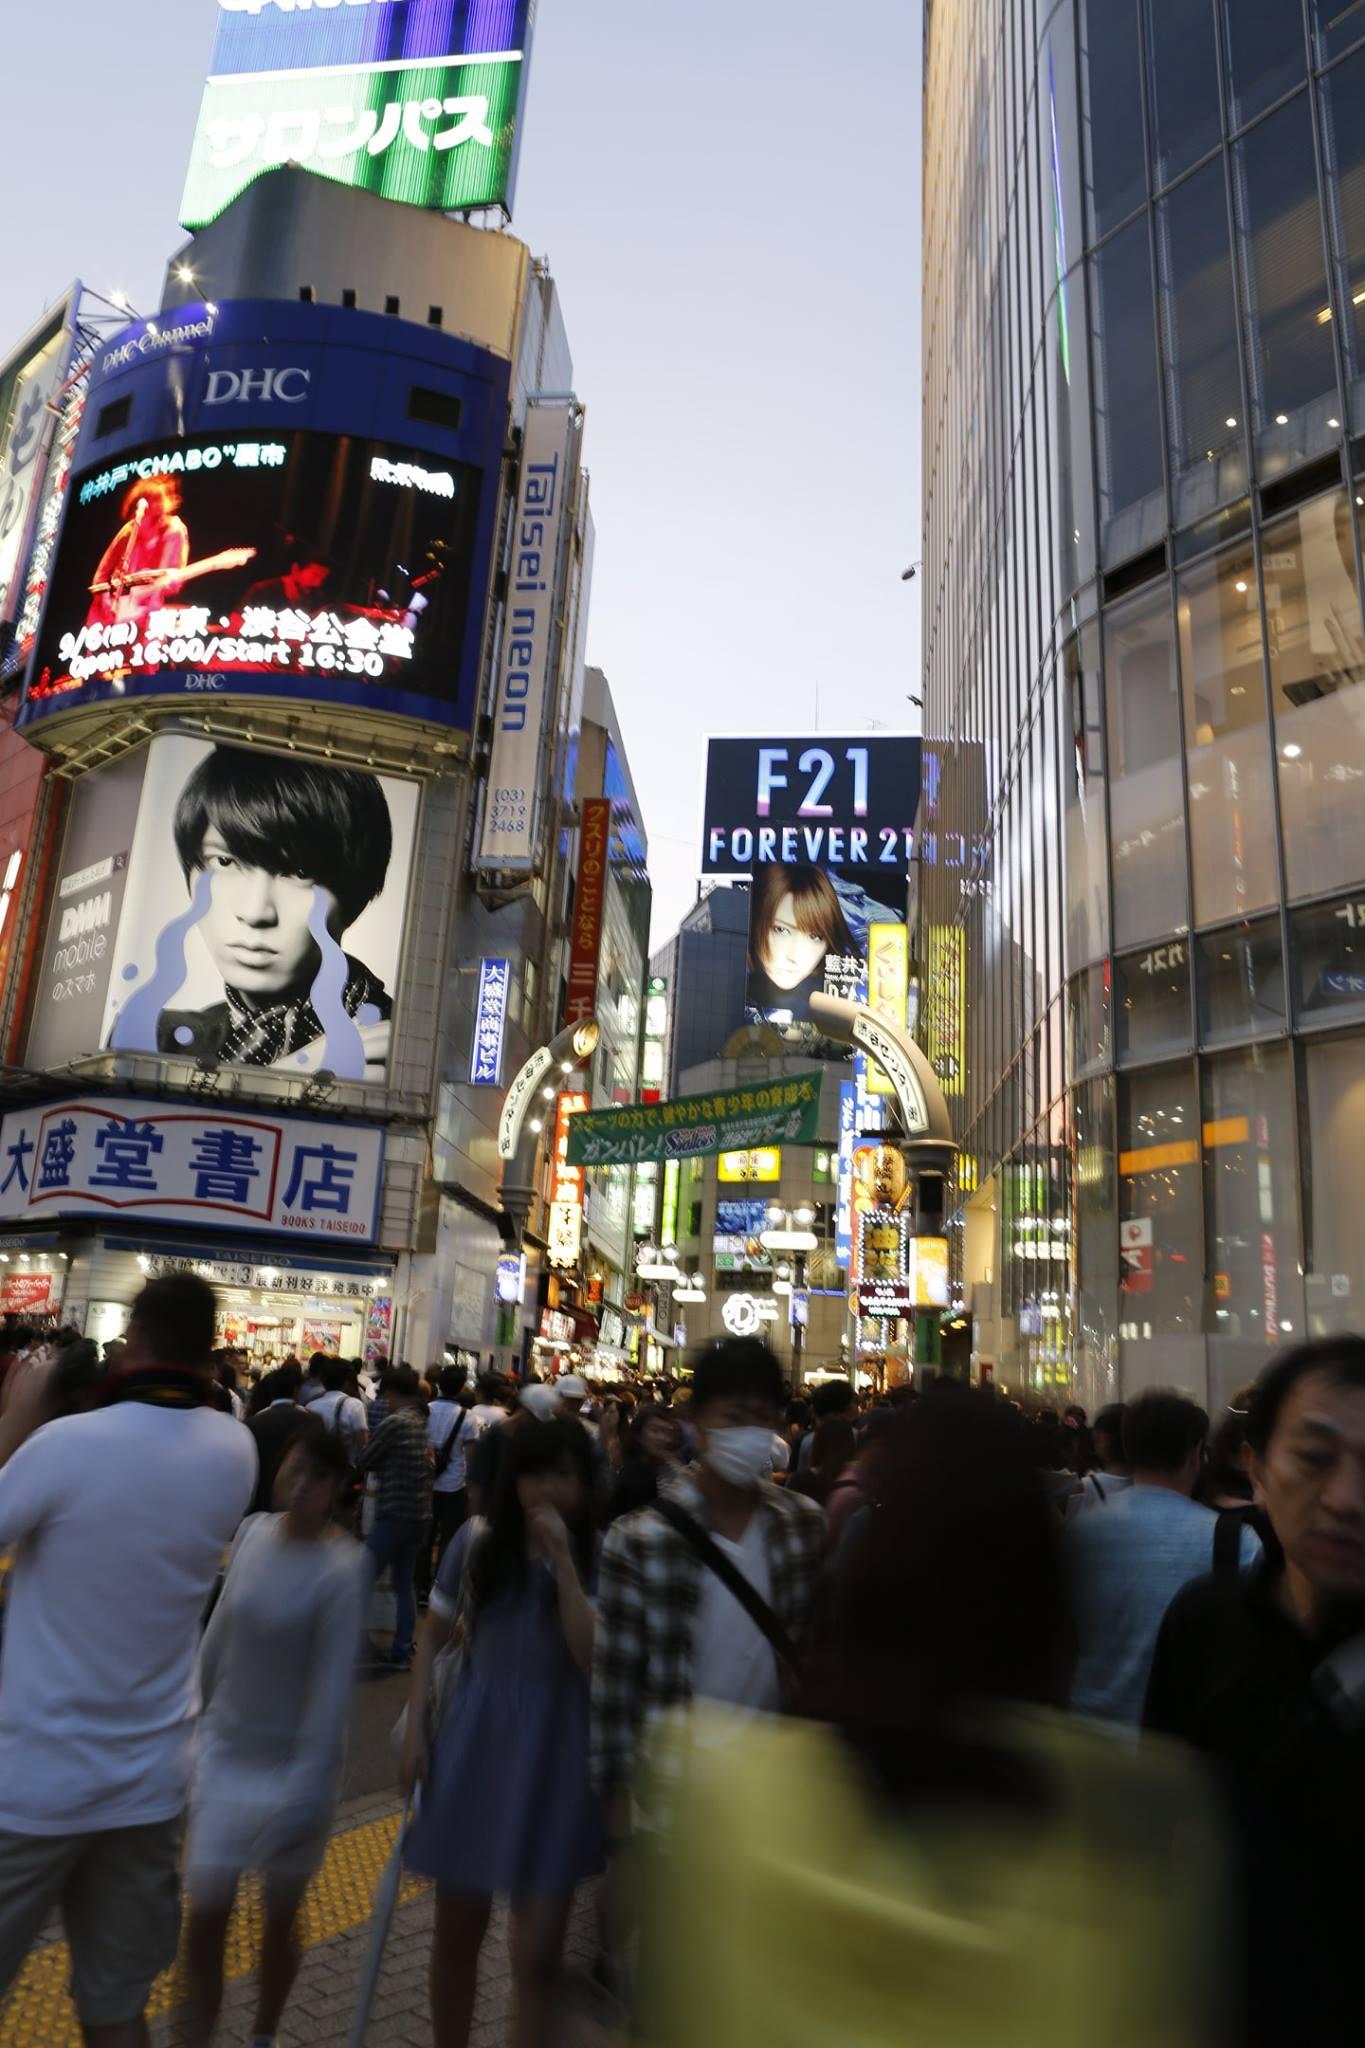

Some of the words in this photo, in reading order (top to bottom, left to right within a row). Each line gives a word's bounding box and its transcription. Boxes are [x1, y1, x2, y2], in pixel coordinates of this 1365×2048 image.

[207, 95, 493, 168] サロンパス
[102, 341, 137, 373] DHC
[138, 316, 214, 353] Channel
[202, 366, 311, 405] DHC
[515, 451, 559, 591] Taisei
[298, 642, 385, 677] 16:30
[501, 607, 536, 731] neon
[184, 673, 227, 691] DHC
[494, 788, 525, 803] (03)
[756, 747, 870, 818] F21
[490, 804, 527, 819] 3719
[490, 818, 526, 833] 2468
[708, 826, 870, 863] FOREVER
[878, 826, 914, 863] 21
[578, 805, 606, 950] クスリのことなら
[58, 890, 113, 944] DMM
[52, 929, 108, 974] mobile
[52, 969, 96, 1001] のスマホ
[1, 1117, 358, 1215] 大盛堂書店
[280, 1214, 316, 1230] BOOKS
[319, 1217, 366, 1235] TAISEIDO
